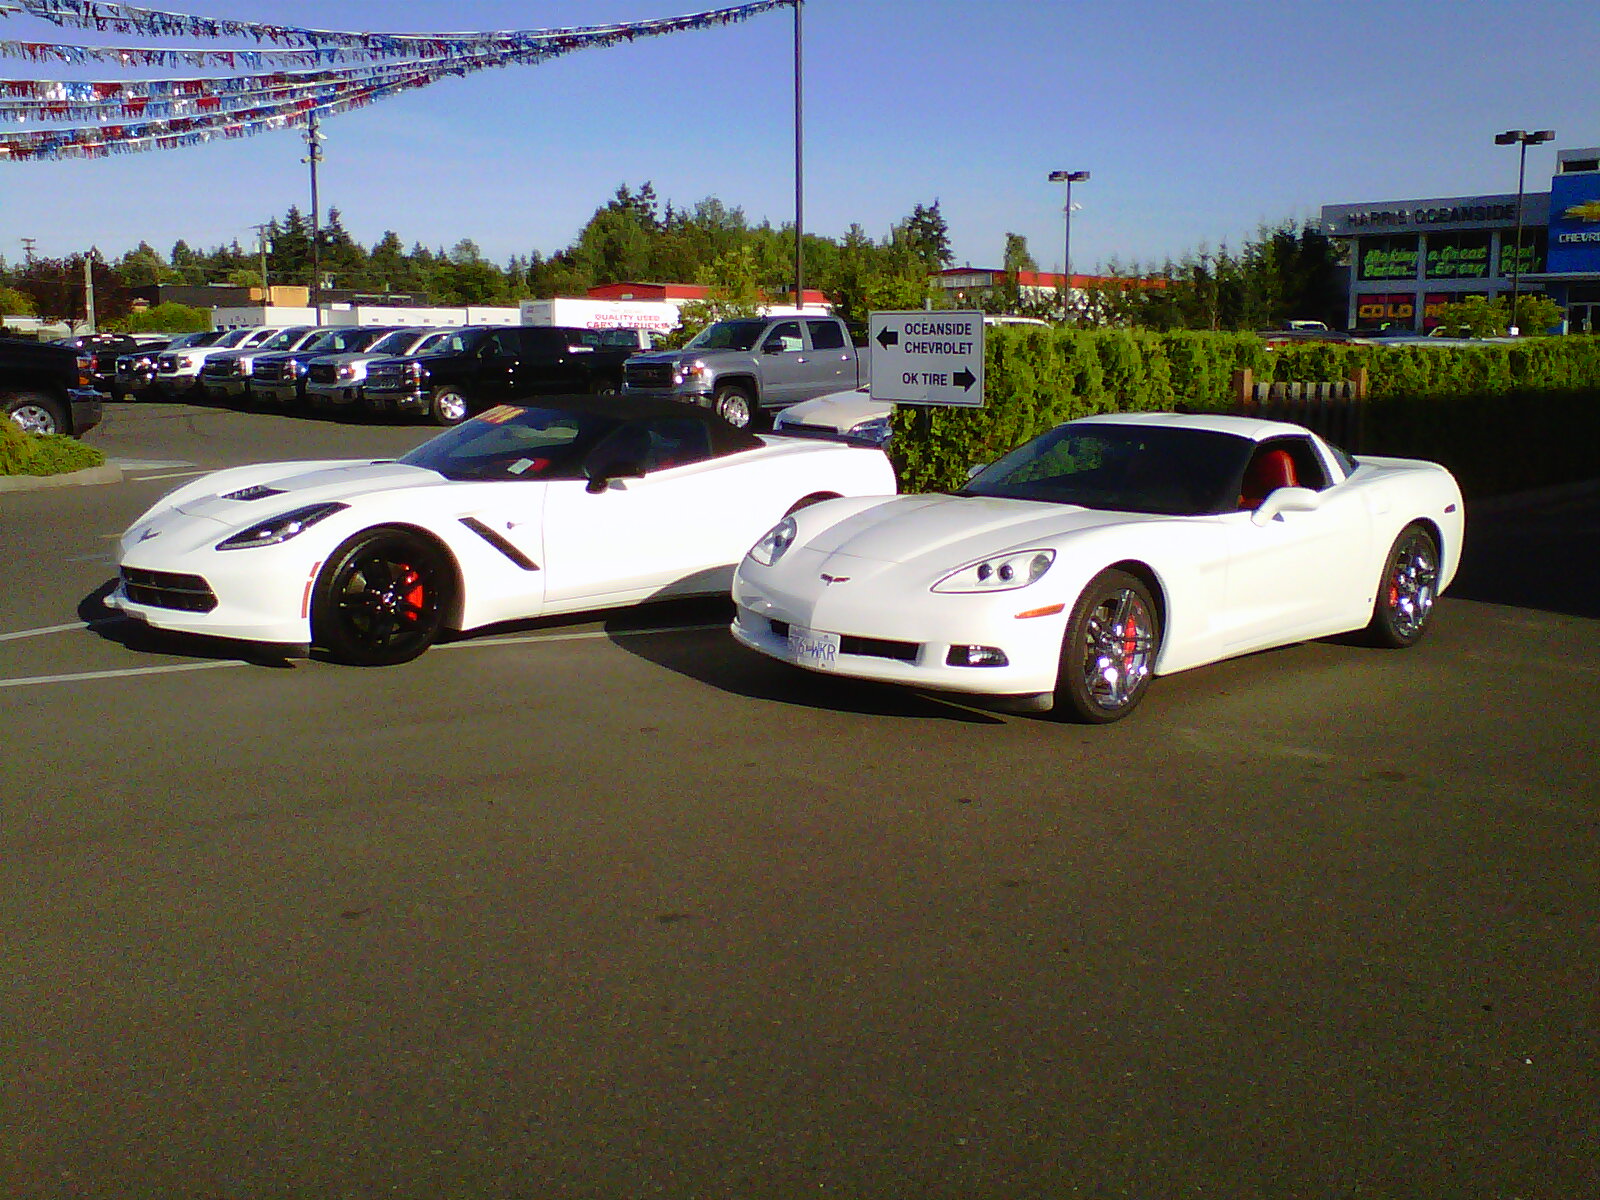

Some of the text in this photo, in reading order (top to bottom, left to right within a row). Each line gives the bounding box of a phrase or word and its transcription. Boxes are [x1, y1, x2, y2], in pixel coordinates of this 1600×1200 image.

[1415, 205, 1515, 224] OCEANSIDE
[594, 313, 660, 322] QUALITY USED
[586, 321, 613, 329] CARS
[904, 323, 972, 336] OCEANSIDE
[904, 341, 973, 355] CHEVROLET
[902, 372, 948, 386] OK TIRE
